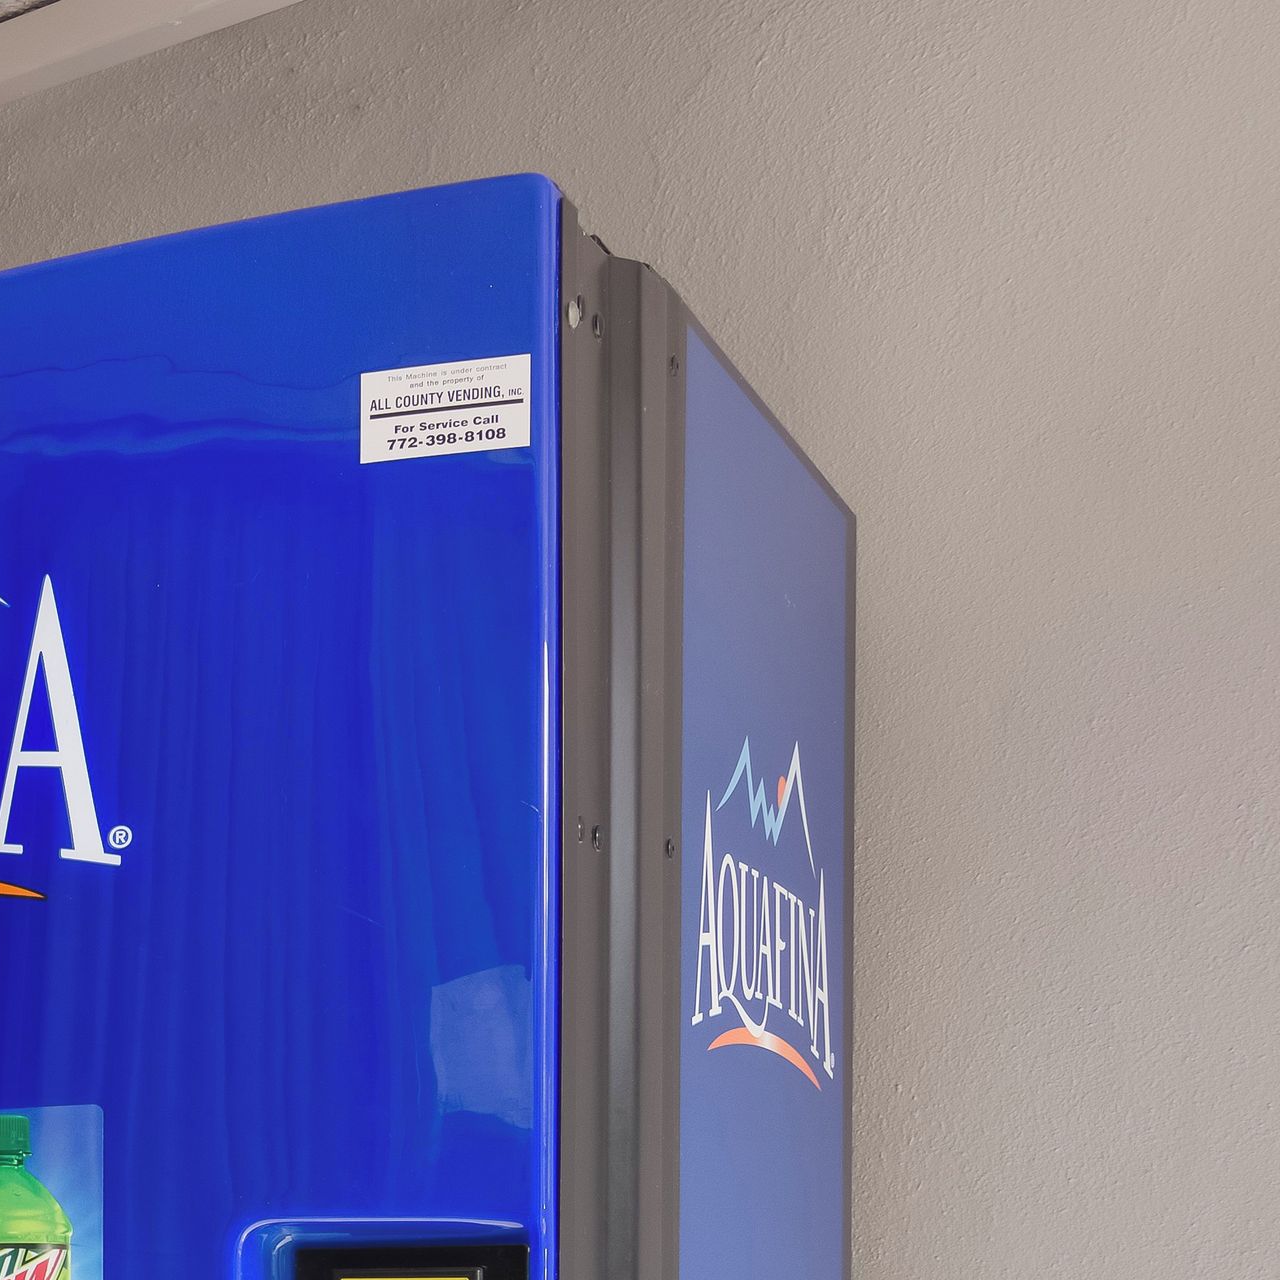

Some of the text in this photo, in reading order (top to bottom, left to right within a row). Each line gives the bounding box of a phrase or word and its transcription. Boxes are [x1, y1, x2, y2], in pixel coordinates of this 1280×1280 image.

[387, 363, 508, 383] This Machine is under contract
[409, 374, 485, 389] and the property of
[369, 385, 525, 412] ALL COUNTY VENDING, INC.
[394, 414, 499, 434] For Service Call
[386, 427, 507, 451] 772-398-8108
[691, 789, 834, 1080] AQUAFINA
